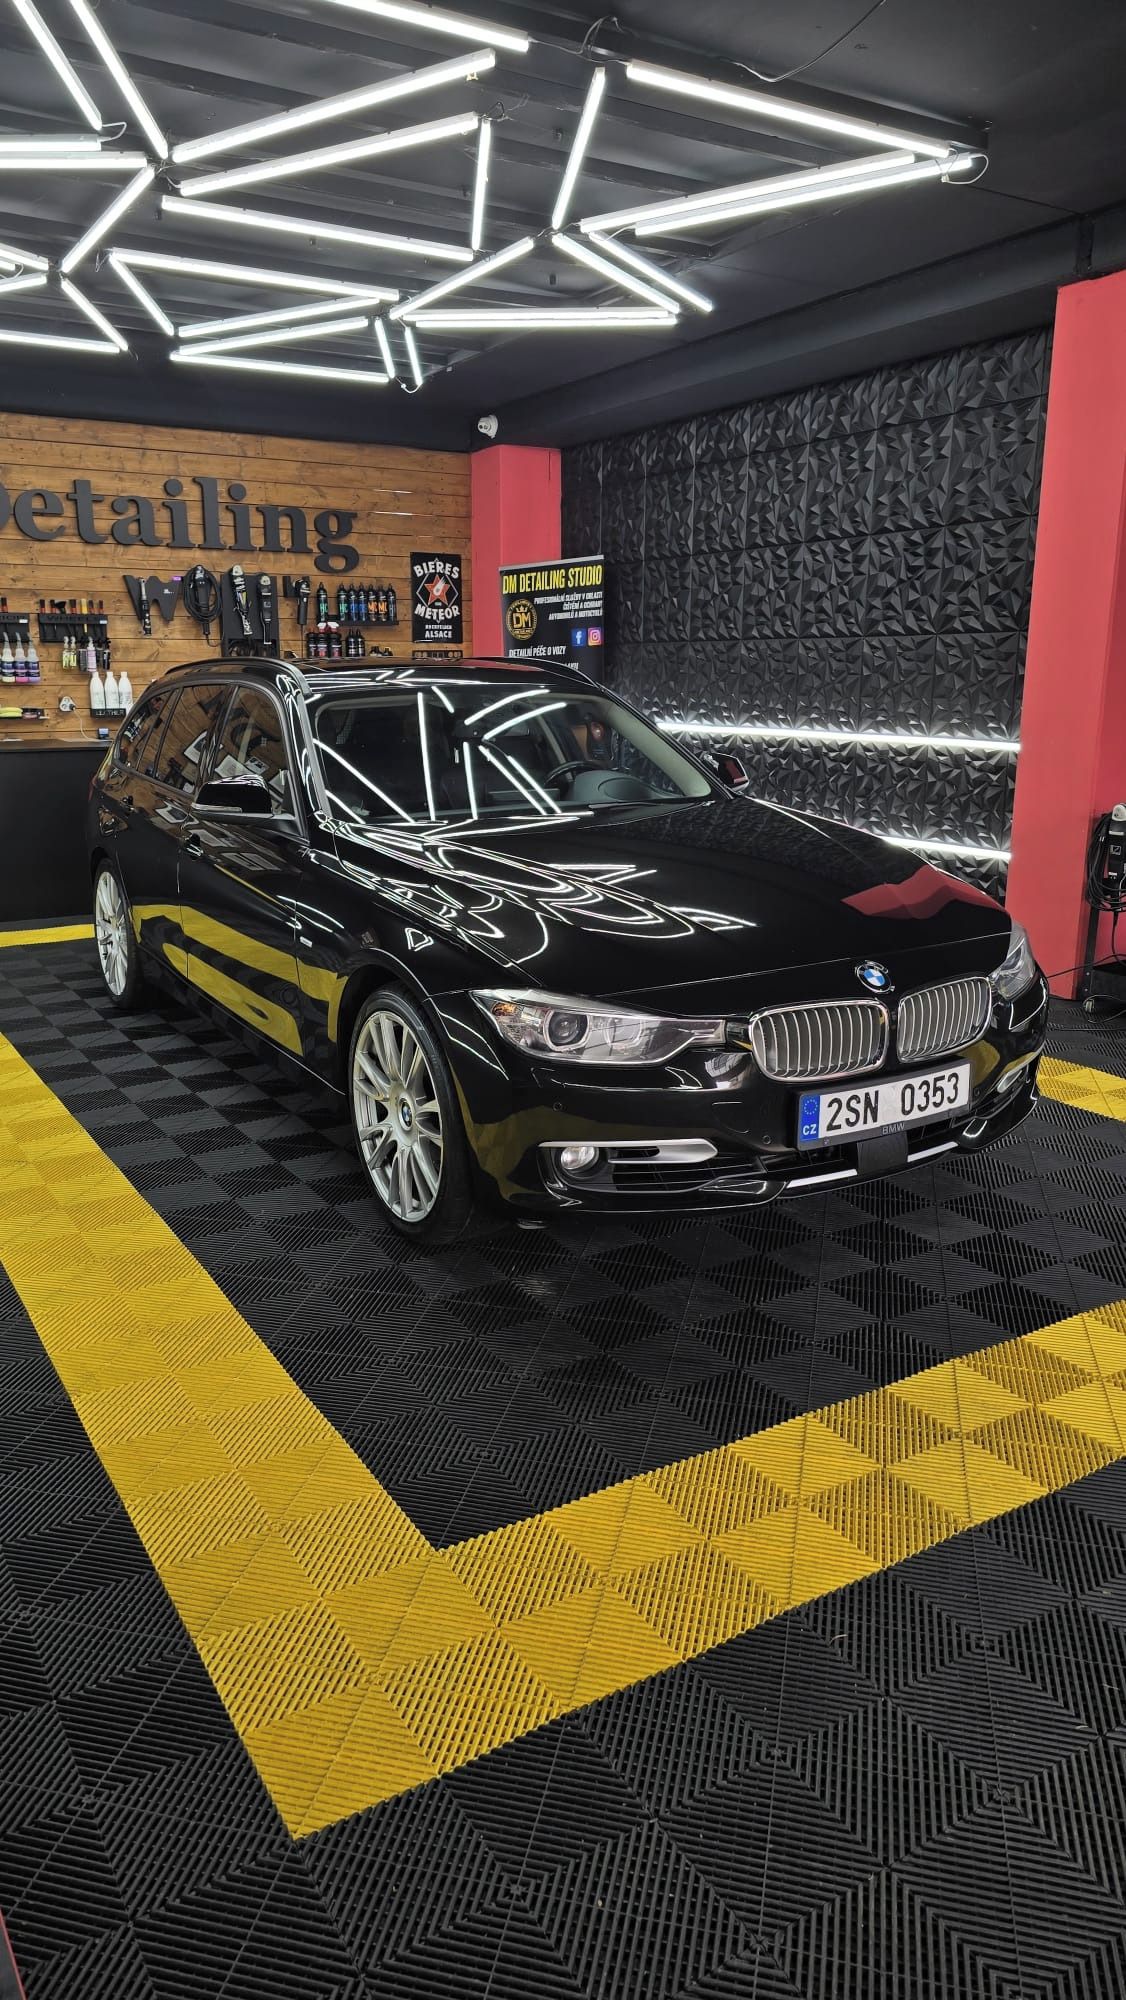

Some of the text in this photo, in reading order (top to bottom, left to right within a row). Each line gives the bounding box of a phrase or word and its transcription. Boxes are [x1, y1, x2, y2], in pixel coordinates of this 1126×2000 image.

[0, 477, 360, 574] etailing
[413, 561, 460, 579] BIERES
[502, 564, 603, 595] DM DETAILING STUDIO
[414, 603, 460, 621] METEOR
[512, 612, 532, 628] DM
[424, 630, 452, 639] ALSACE
[552, 645, 567, 655] VOZY
[803, 1072, 959, 1136] CZ 2SN 0353
[882, 1122, 905, 1135] BMW
